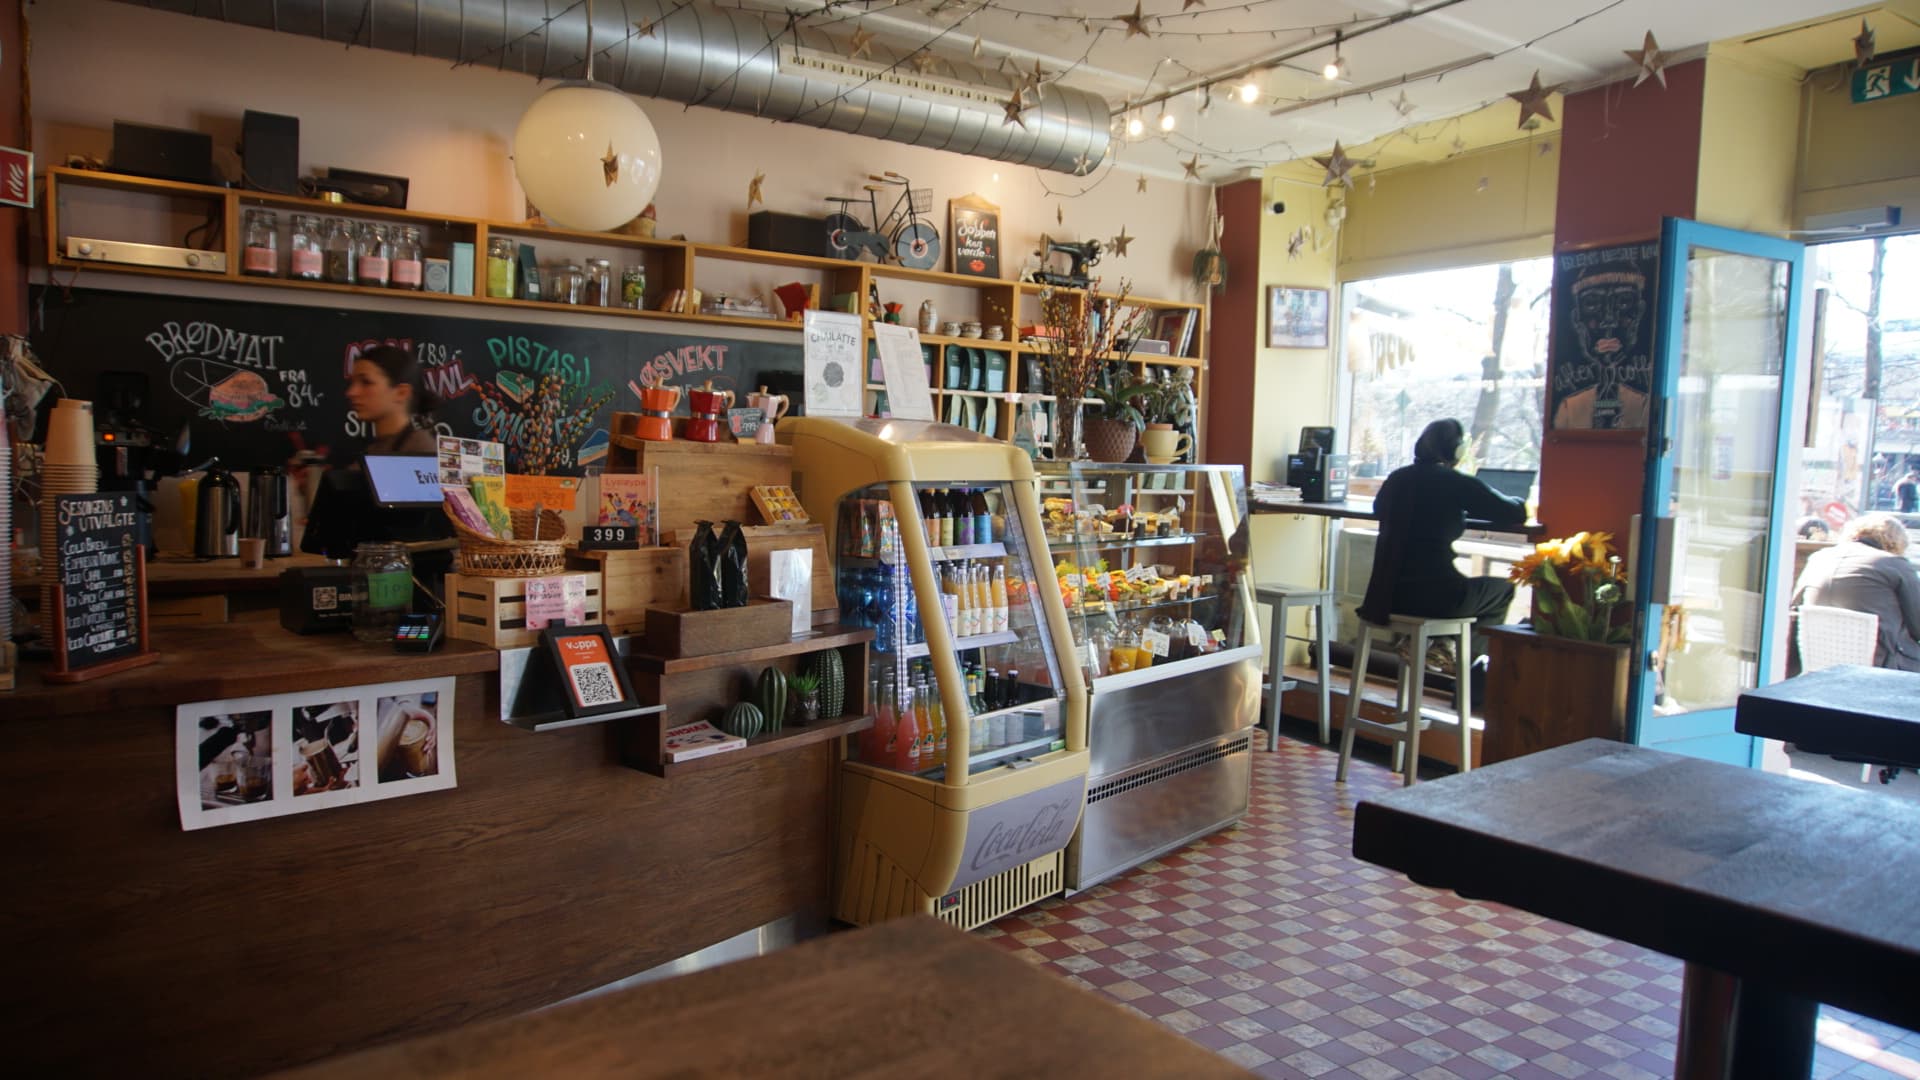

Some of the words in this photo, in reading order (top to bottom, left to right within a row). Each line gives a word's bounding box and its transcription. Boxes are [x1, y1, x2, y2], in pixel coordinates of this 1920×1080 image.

[145, 321, 284, 369] BRØDMAT
[486, 335, 590, 387] PISTASJ
[279, 370, 307, 382] FRA
[79, 512, 136, 532] UTVALGTE
[593, 528, 625, 541] 399
